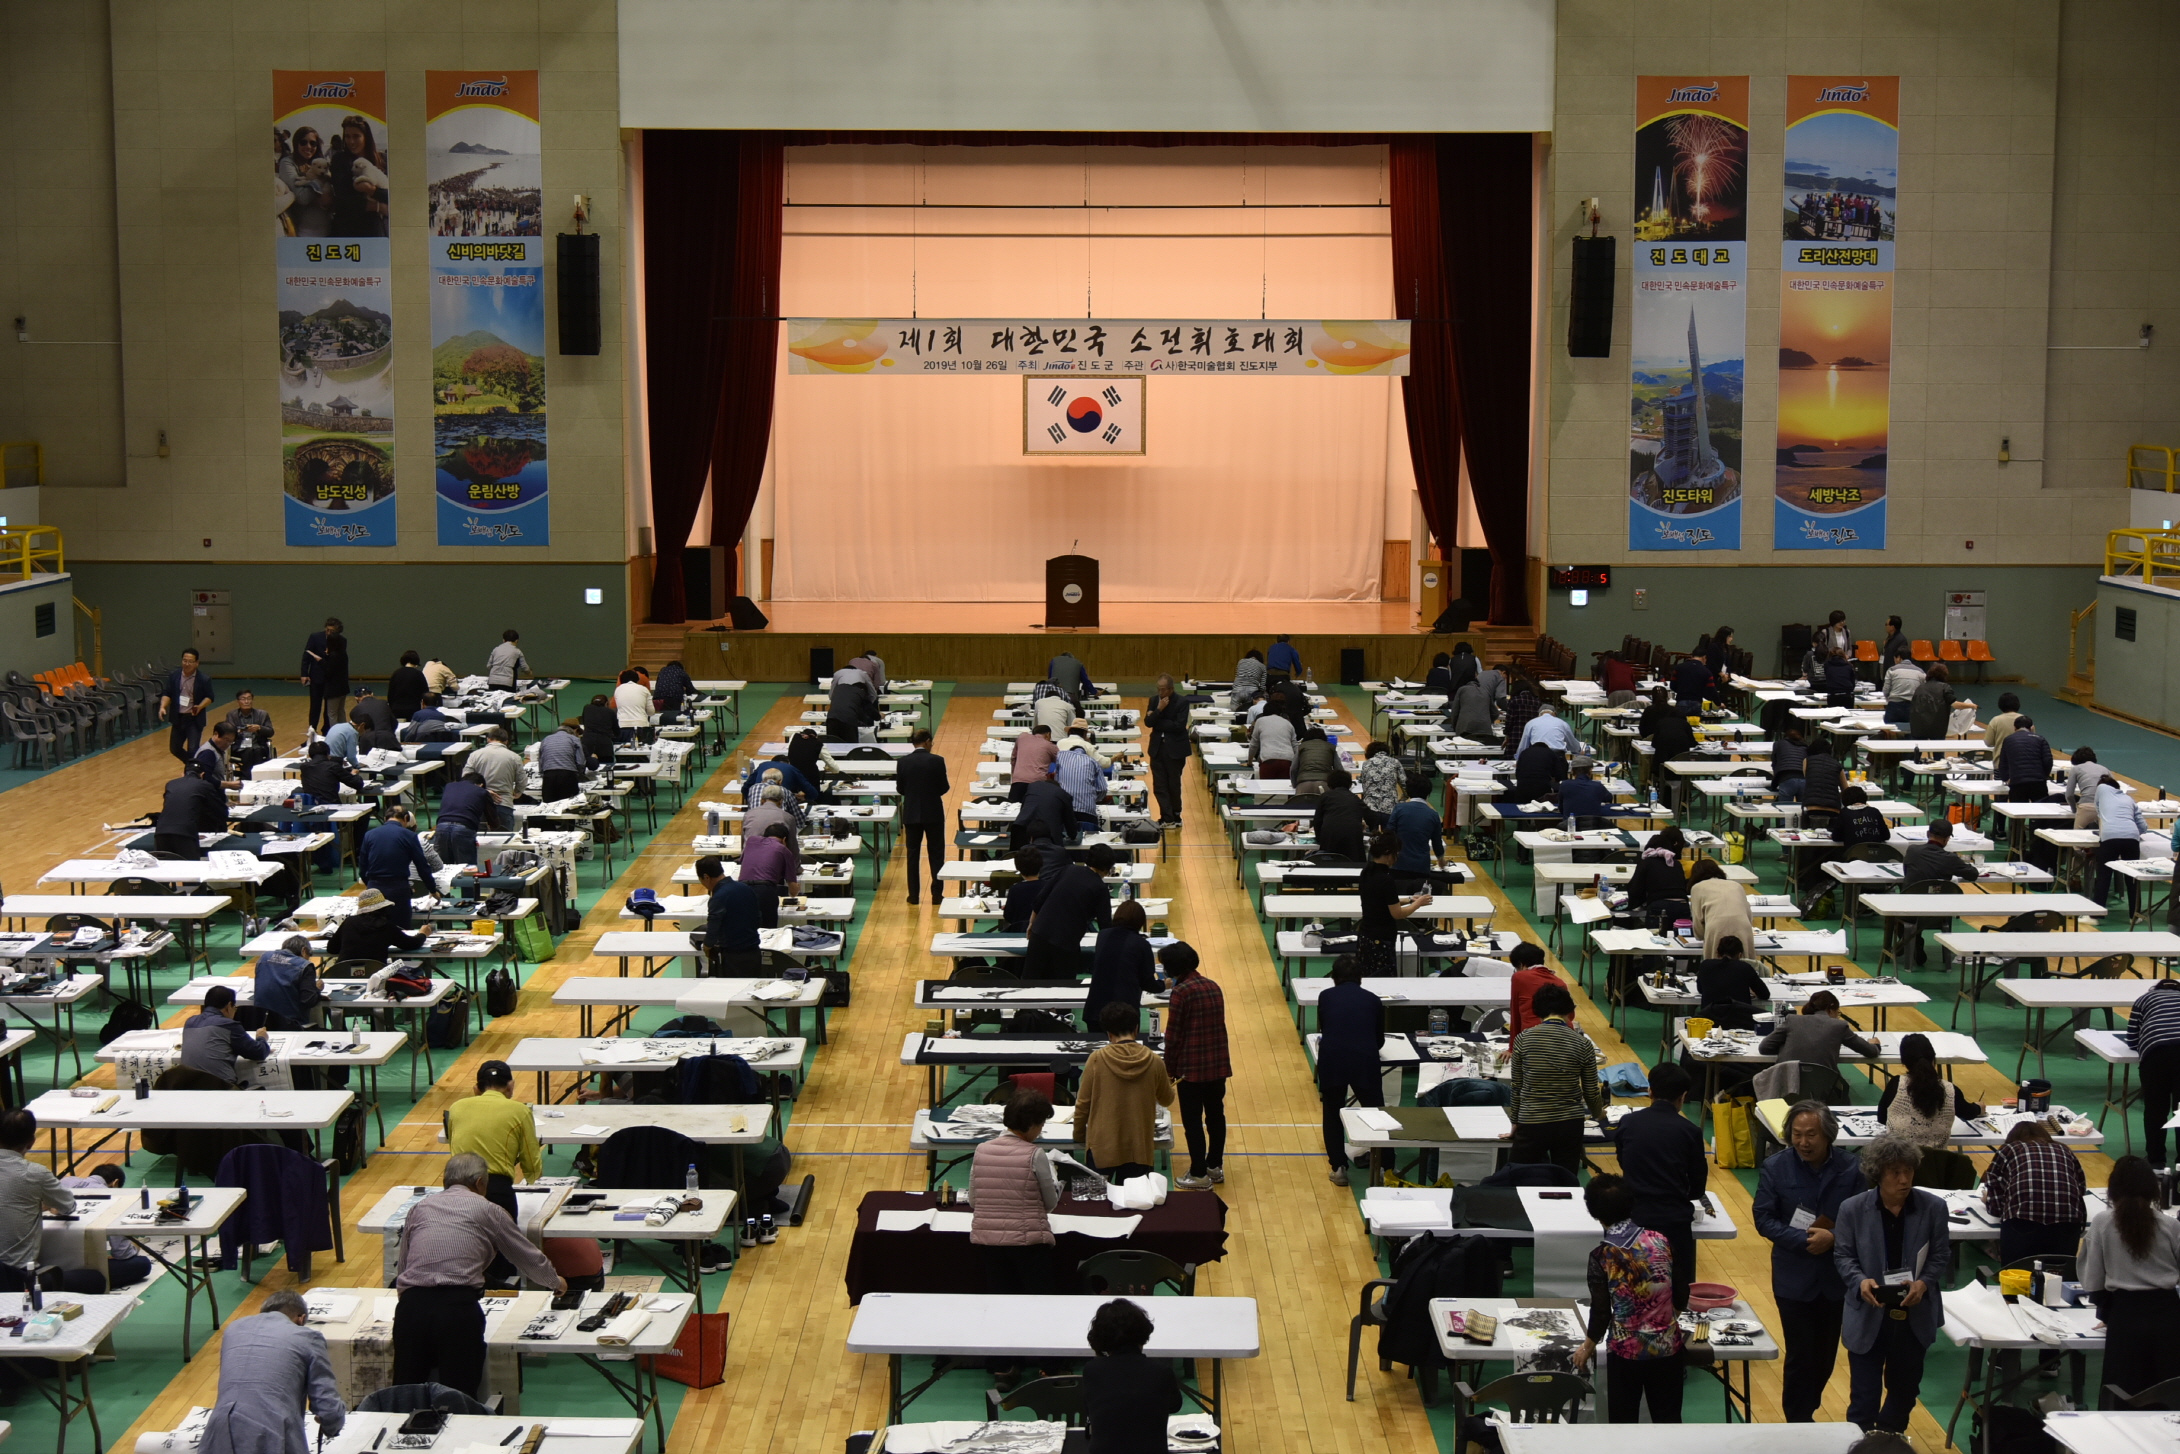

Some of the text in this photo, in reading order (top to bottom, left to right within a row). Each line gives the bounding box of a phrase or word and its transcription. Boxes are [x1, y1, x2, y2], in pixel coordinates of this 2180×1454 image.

[302, 79, 349, 99] Jindo
[455, 78, 502, 98] Jindo
[1666, 84, 1712, 104] Jindo
[1816, 84, 1862, 104] Jindo
[447, 243, 526, 262] 신비의바닷길
[1799, 248, 1878, 266] 도리산전망대
[286, 277, 382, 288] 대한민국 민속문화예술특구
[438, 276, 536, 287] 대한민국 민속문화예술특구
[1641, 281, 1738, 292] 대한민국 민속문화예술특구
[1789, 280, 1885, 291] 대한민국 민속문화예술특구
[898, 325, 963, 356] 제1회
[990, 325, 1108, 357] 대한민국
[923, 359, 957, 371] 2019년
[961, 359, 982, 371] 10월
[985, 359, 1008, 371] 26일
[1017, 360, 1038, 371] 주최
[1124, 360, 1143, 371] 주관
[1239, 360, 1278, 371] 진도지부
[316, 484, 367, 501] 남도진성
[467, 483, 520, 501] 운림산방
[1662, 488, 1714, 505] 진도타워
[1809, 487, 1862, 504] 세방낙조
[342, 523, 370, 541] 진도
[494, 523, 522, 541] 진도
[1686, 527, 1715, 545] 진도
[1830, 527, 1859, 545] 진도
